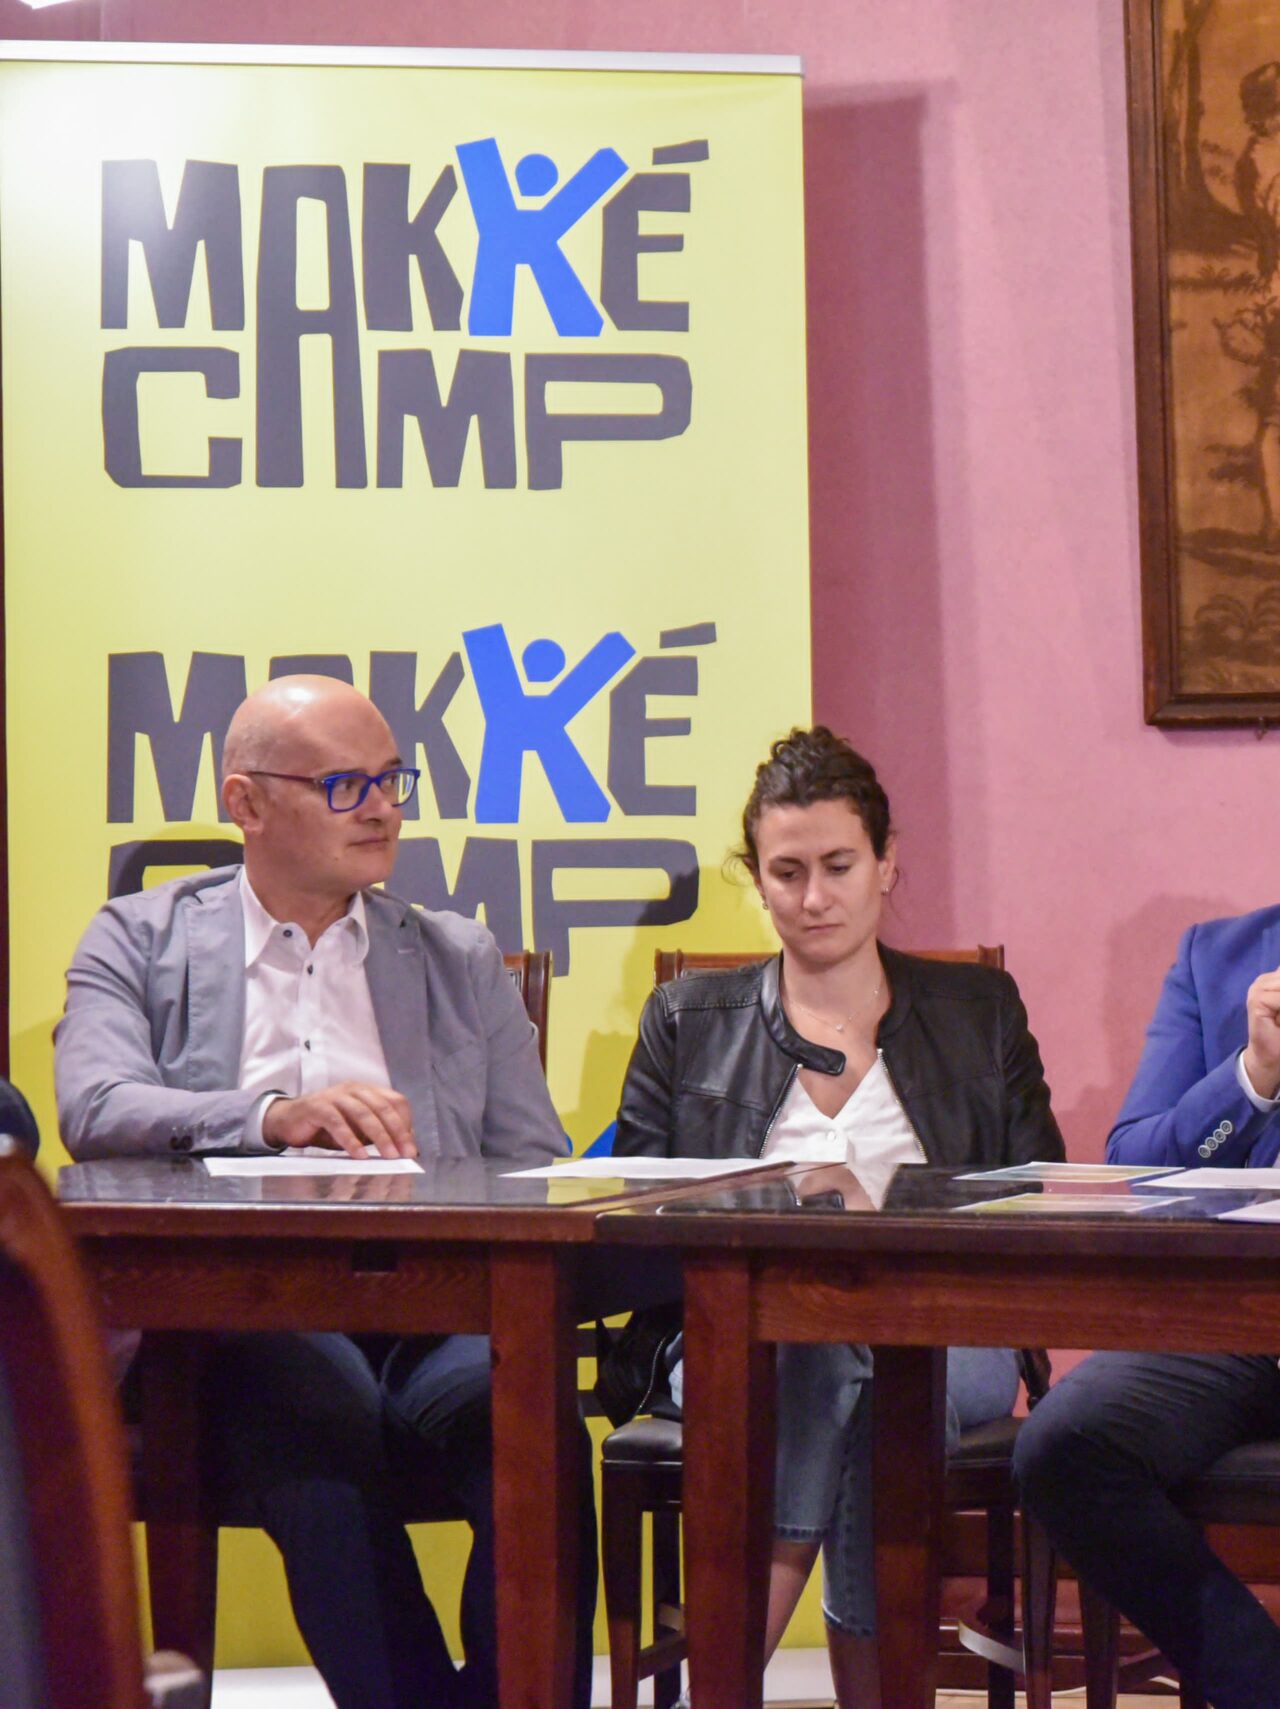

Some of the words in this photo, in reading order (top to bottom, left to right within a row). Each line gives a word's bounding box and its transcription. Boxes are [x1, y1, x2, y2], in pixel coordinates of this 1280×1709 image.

[100, 137, 710, 338] MAKKÉ
[102, 346, 693, 490] CAMP
[107, 622, 718, 824] MKKÉ
